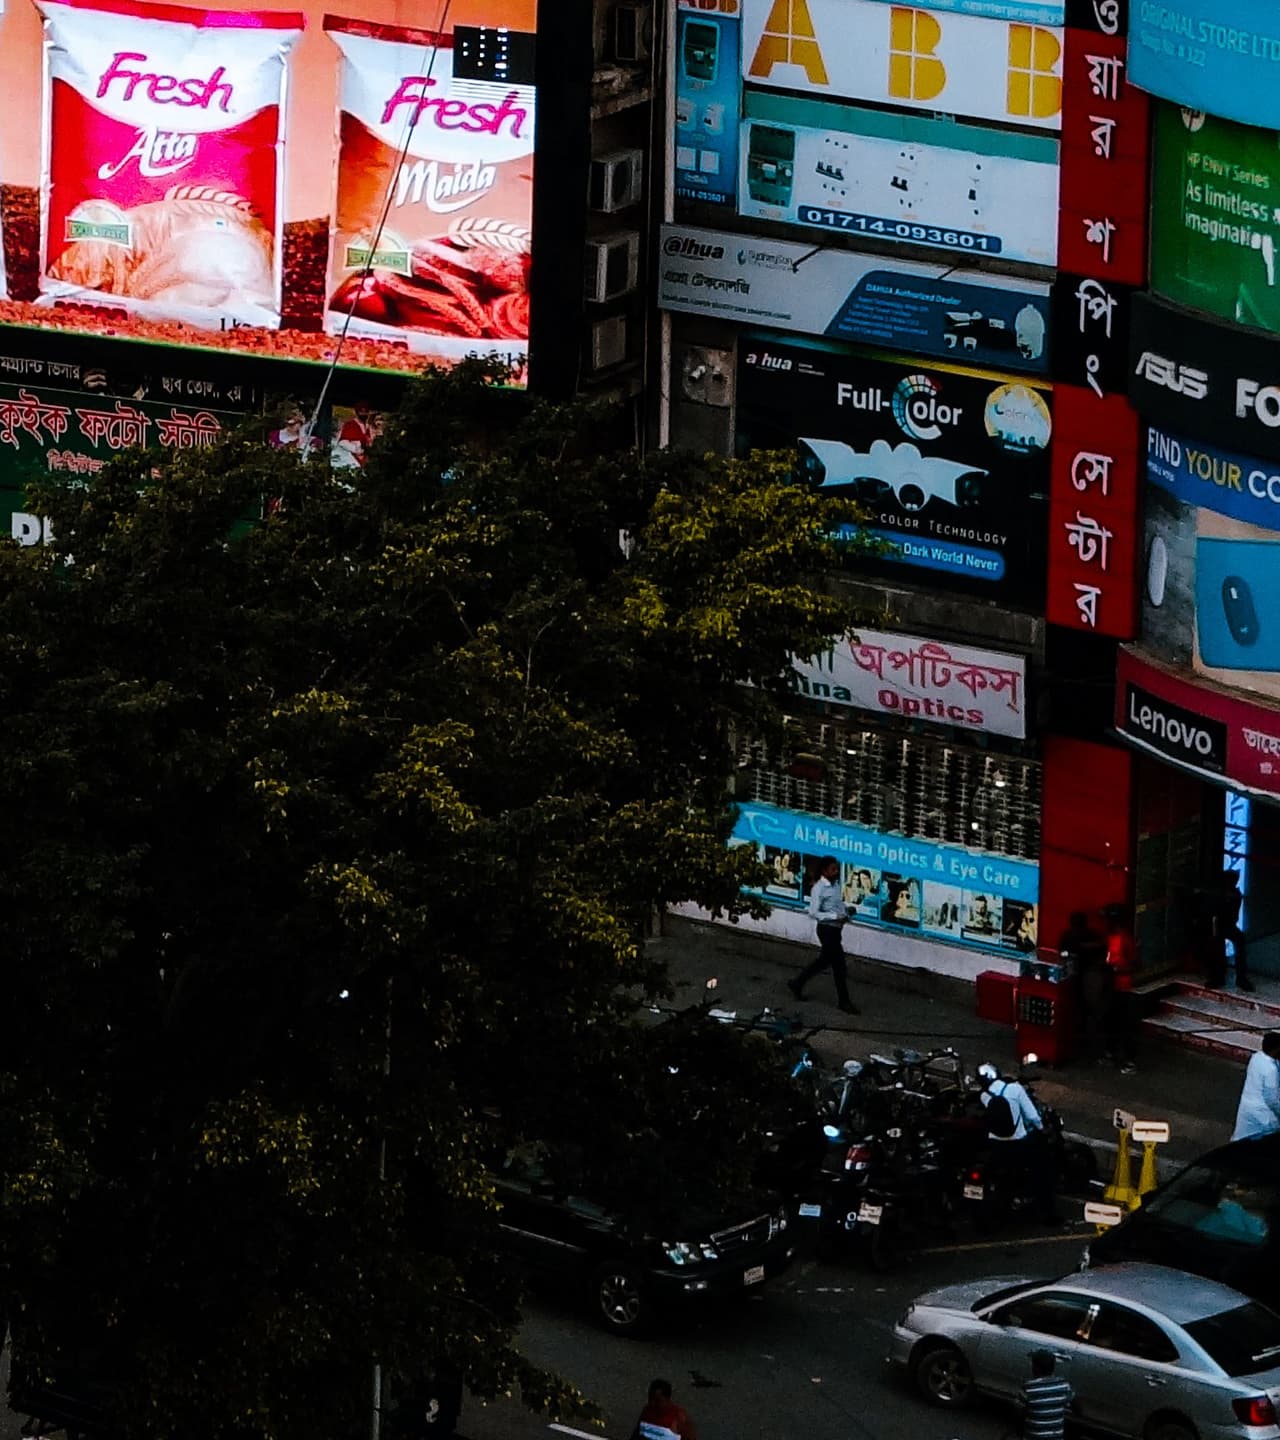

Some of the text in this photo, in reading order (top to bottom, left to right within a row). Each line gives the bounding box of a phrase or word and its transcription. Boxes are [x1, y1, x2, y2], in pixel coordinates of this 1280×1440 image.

[1198, 21, 1249, 55] STORE
[95, 50, 234, 116] Fresh
[380, 75, 530, 140] Fresh
[97, 126, 199, 181] Atta
[1232, 165, 1271, 189] Series
[391, 159, 498, 216] Maida
[1185, 179, 1269, 222] As limitless
[806, 208, 990, 251] 01714-093601
[1135, 351, 1209, 400] ASUS
[74, 400, 153, 451] ফটো
[1147, 426, 1181, 468] FIND
[1185, 447, 1243, 493] YOUR
[903, 541, 999, 572] Dark World Never
[929, 519, 1008, 546] TECHNOLOGY
[878, 689, 984, 726] Optics
[1130, 691, 1213, 756] Lenovo
[793, 823, 1020, 889] Al-Madina Optics & Eye Care
